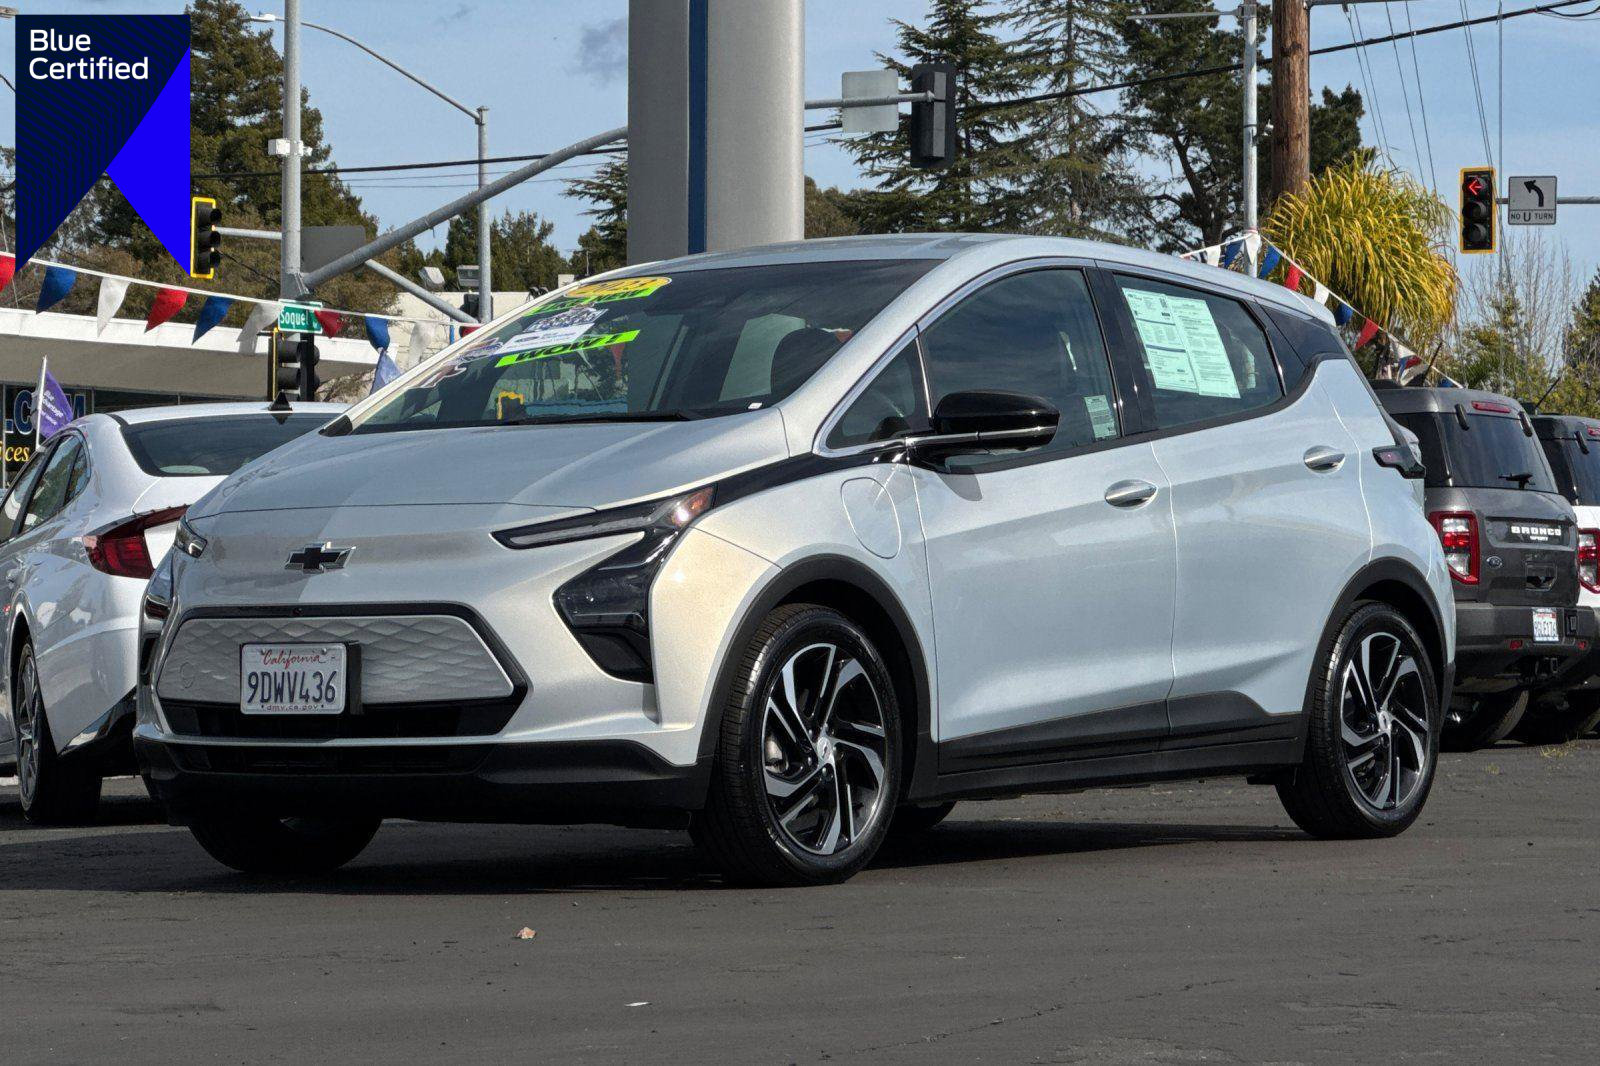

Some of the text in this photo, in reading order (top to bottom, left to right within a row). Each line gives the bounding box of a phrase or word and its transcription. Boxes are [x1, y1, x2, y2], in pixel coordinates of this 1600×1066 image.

[1523, 212, 1531, 222] U
[1534, 212, 1553, 220] TURN
[280, 310, 309, 329] Soquel
[1510, 525, 1561, 536] BRONCO
[263, 649, 326, 669] California
[247, 671, 337, 703] 9DWV436
